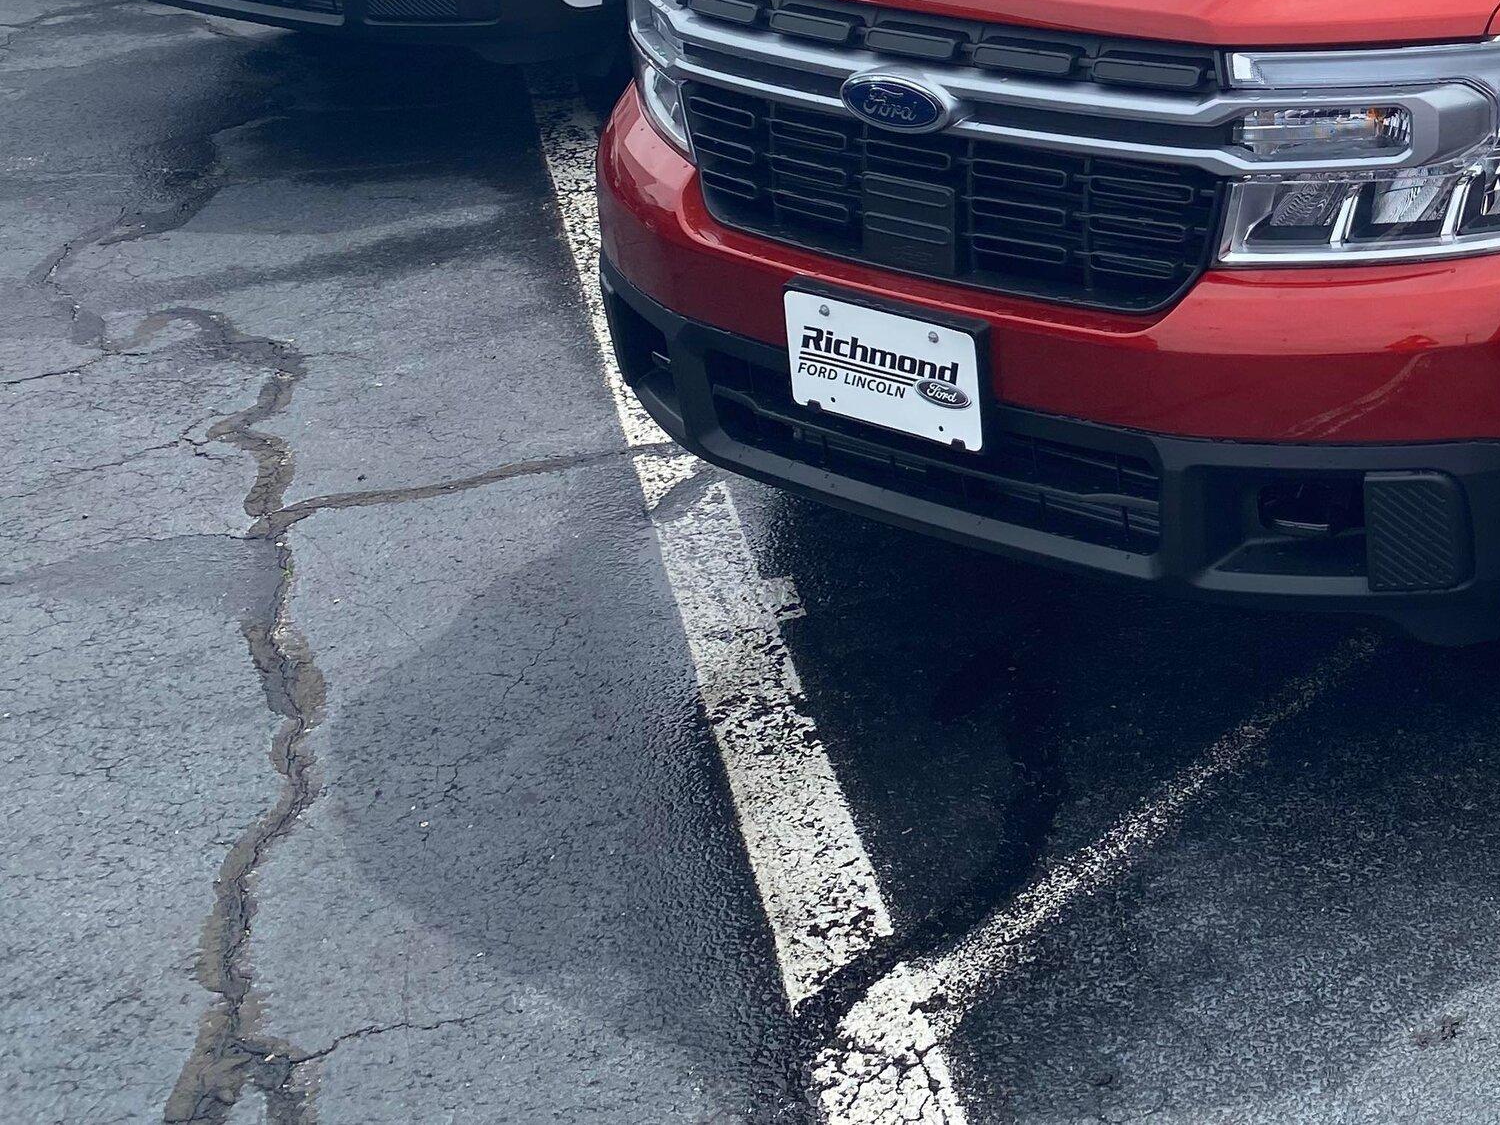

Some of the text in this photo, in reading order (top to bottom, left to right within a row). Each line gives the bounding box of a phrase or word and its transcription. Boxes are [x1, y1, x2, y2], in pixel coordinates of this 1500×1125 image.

[862, 84, 918, 121] Ford
[800, 325, 960, 385] Richmond
[797, 362, 906, 399] FORD LINCOLN
[926, 382, 958, 404] Ford
